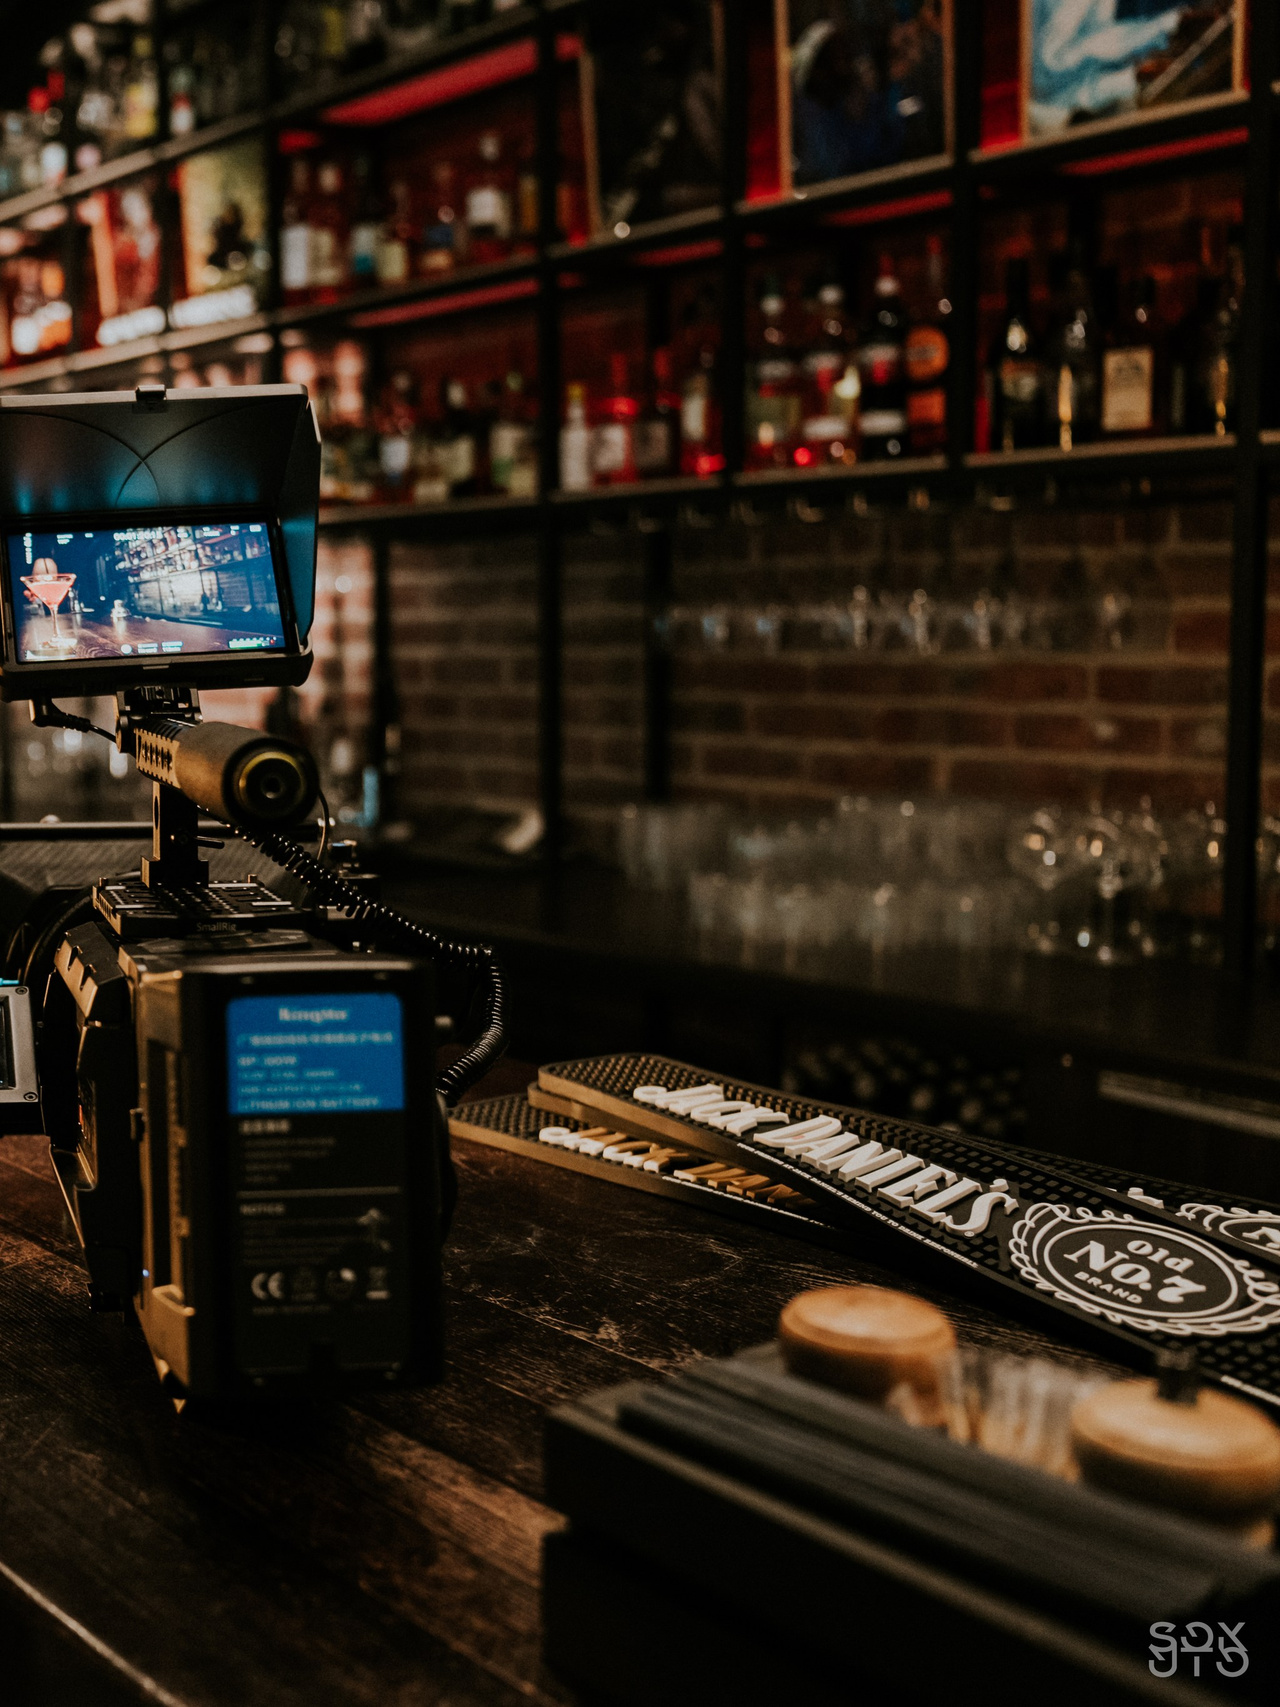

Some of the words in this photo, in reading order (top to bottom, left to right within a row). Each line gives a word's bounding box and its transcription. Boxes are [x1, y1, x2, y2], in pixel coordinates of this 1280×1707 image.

[196, 921, 237, 932] SmallRig
[633, 1083, 790, 1136] JACK
[1074, 1271, 1143, 1304] BRAND
[1157, 1275, 1206, 1303] 7
